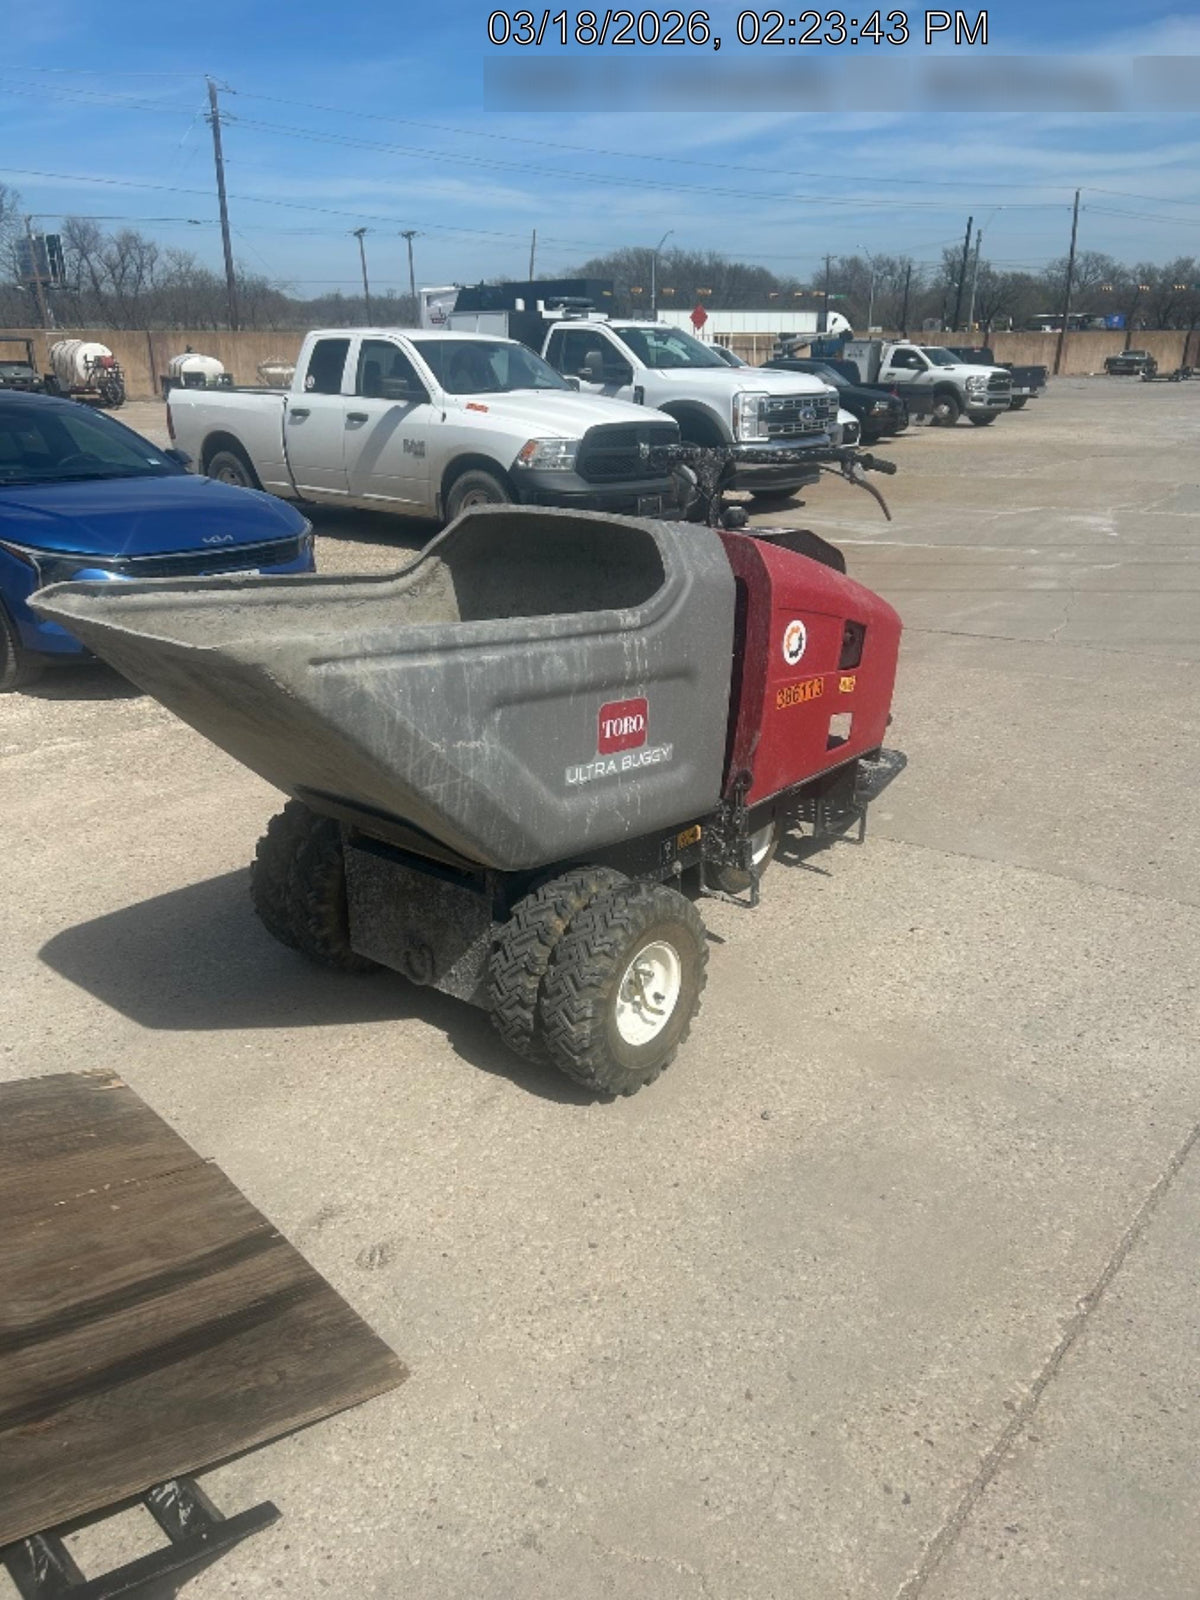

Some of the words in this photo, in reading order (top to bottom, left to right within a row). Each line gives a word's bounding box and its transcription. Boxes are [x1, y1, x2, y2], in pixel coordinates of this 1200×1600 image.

[777, 678, 822, 708] 386113
[602, 714, 645, 739] TORO
[566, 761, 618, 785] ULTRA
[621, 744, 673, 771] BUGGY
